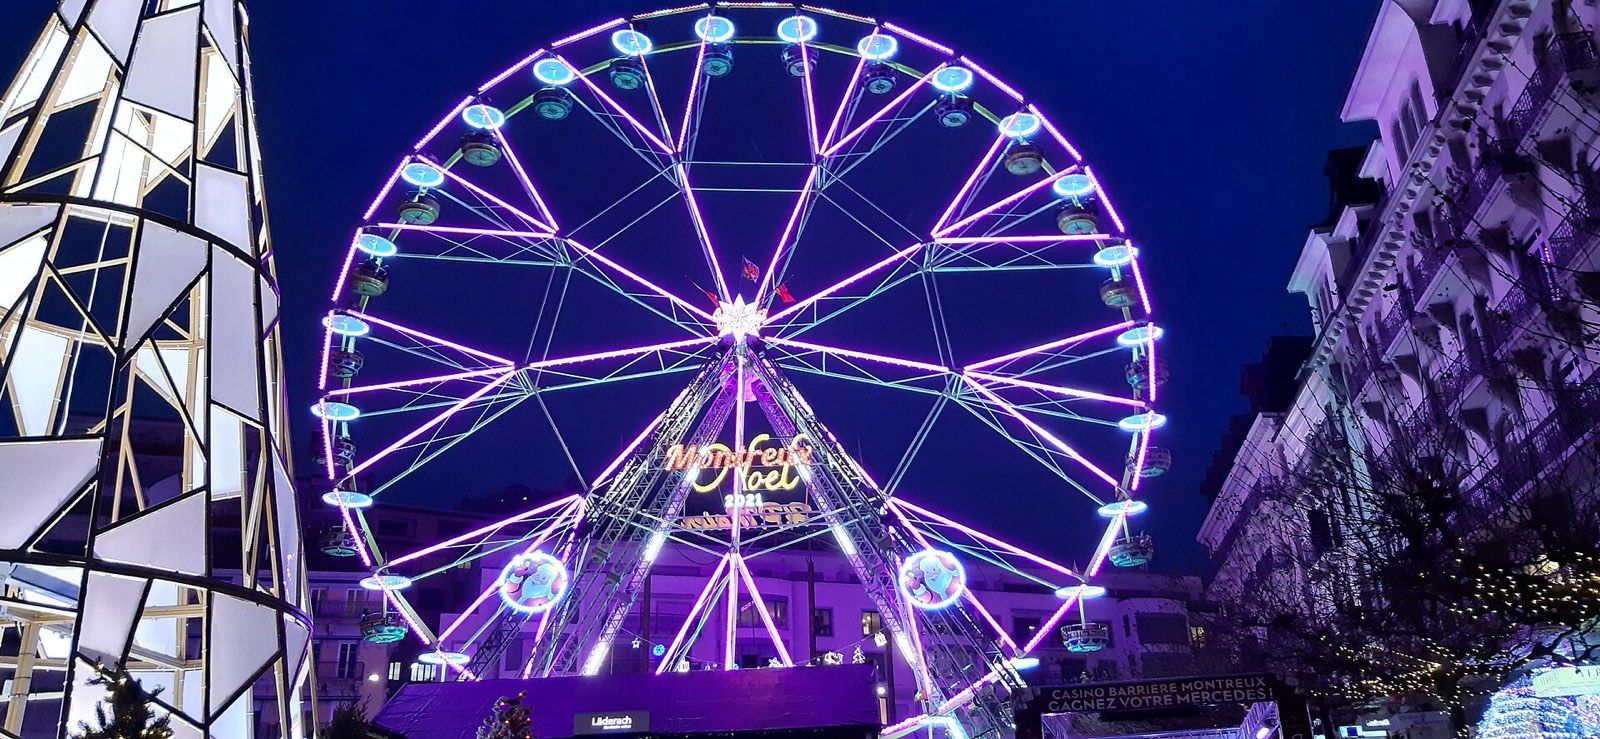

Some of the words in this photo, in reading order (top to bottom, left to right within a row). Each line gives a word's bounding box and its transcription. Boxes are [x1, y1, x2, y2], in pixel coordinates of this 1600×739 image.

[724, 493, 762, 508] 2021
[1052, 688, 1104, 700] CASINO
[1182, 676, 1266, 692] MONTREUX
[1048, 698, 1117, 712] GAGNEZ
[1119, 695, 1173, 708] VOTRE
